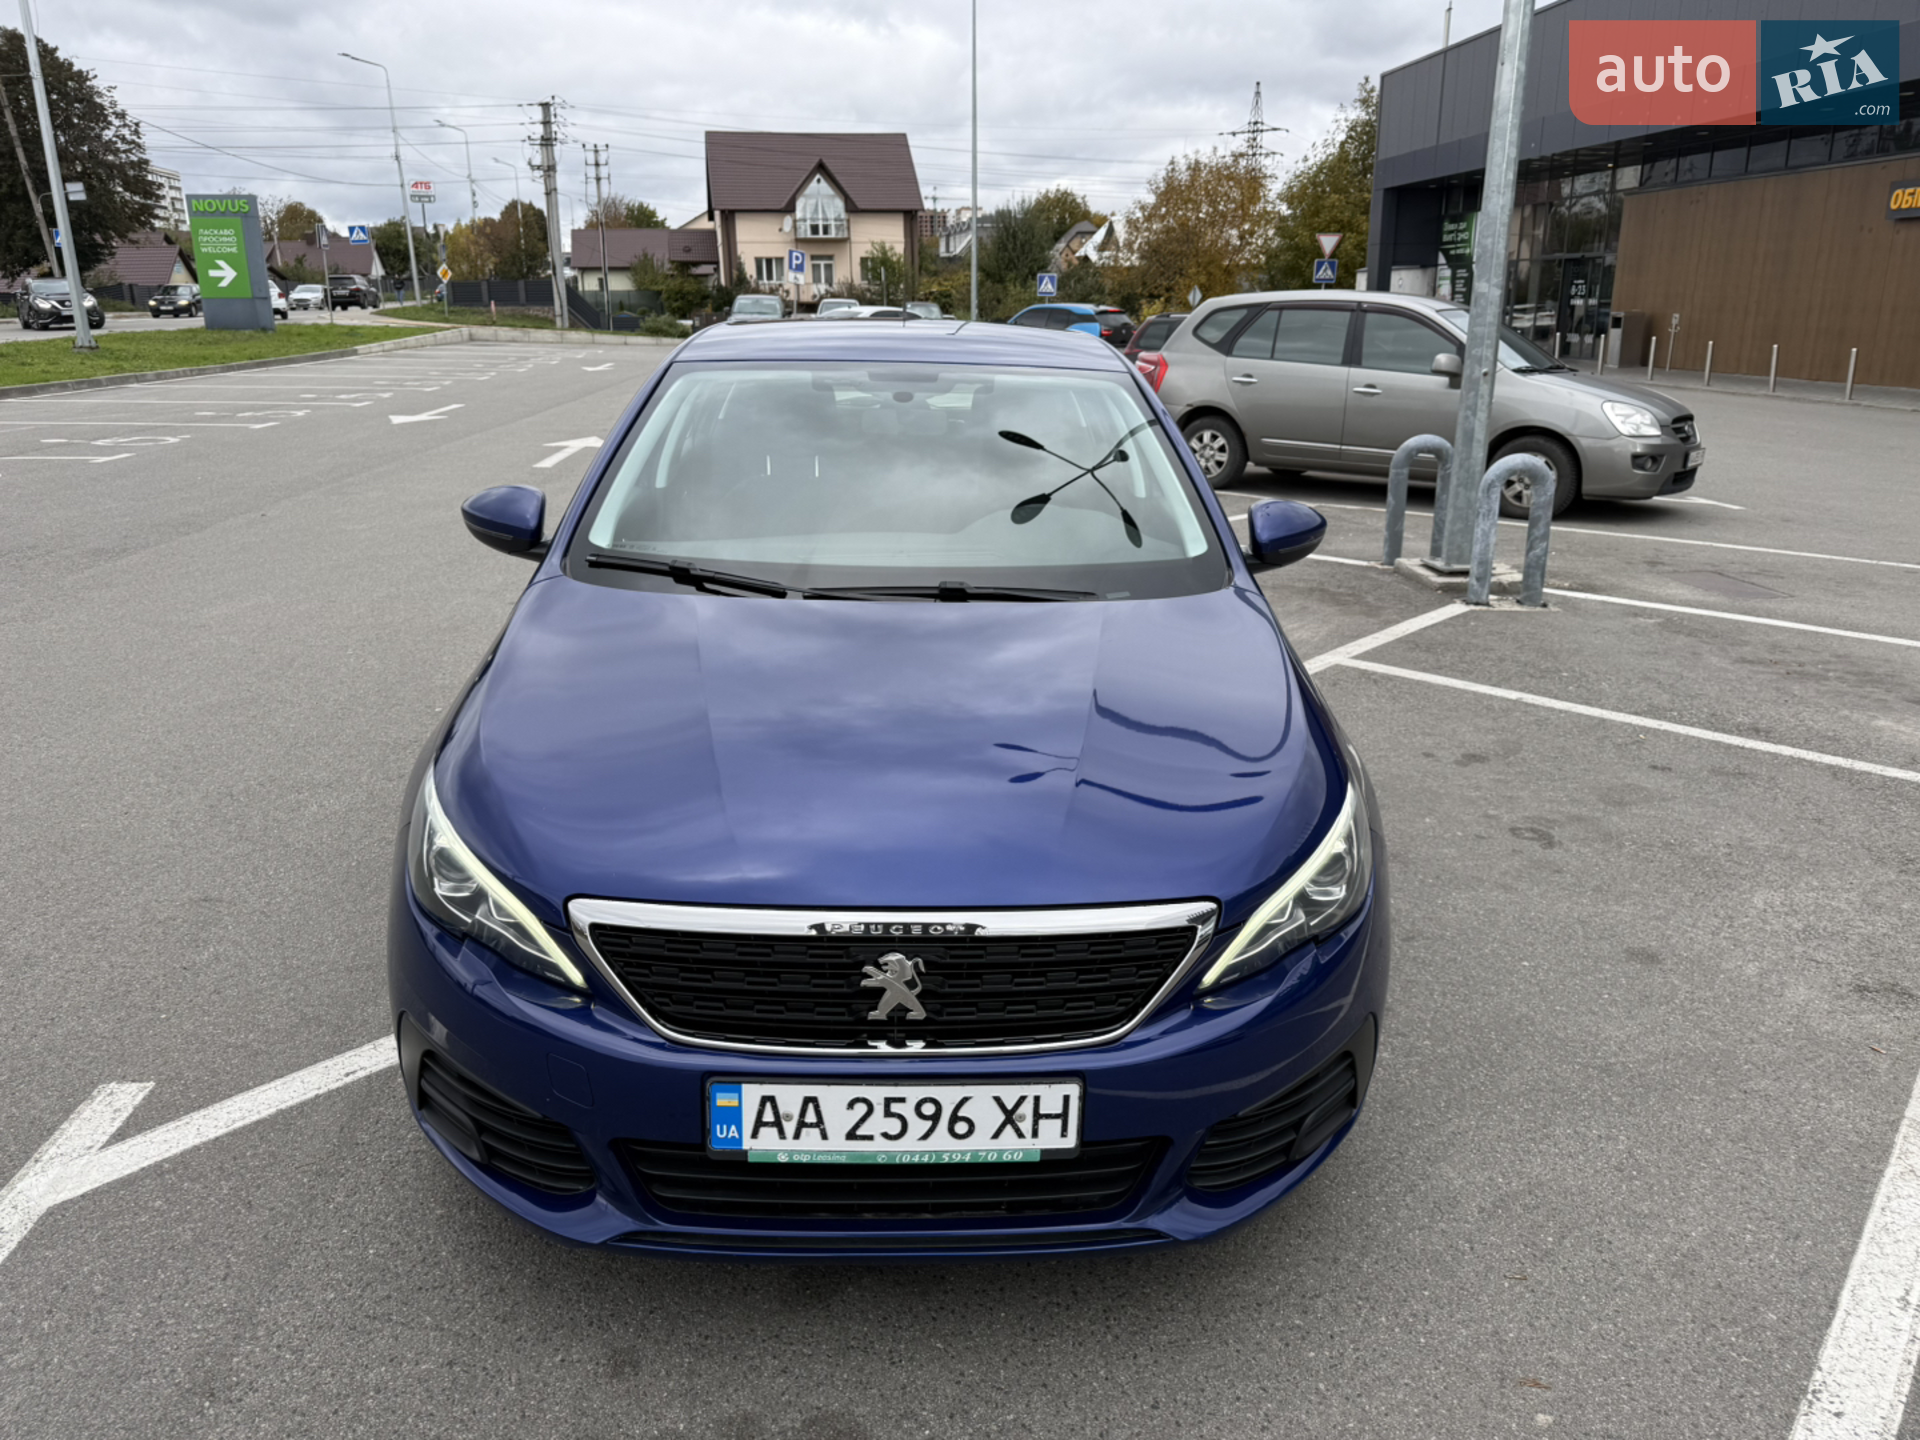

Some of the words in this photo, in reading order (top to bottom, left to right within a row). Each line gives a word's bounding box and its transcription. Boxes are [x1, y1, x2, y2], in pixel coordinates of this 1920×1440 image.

[191, 199, 251, 214] NOVUS
[792, 251, 803, 270] P
[830, 923, 966, 935] PEUGEOT
[750, 1095, 829, 1141] AA
[845, 1095, 976, 1141] 2596
[990, 1094, 1071, 1140] XH
[716, 1125, 741, 1140] UA
[793, 1152, 811, 1163] otp
[895, 1151, 936, 1164] (044)
[939, 1151, 971, 1163] 594
[978, 1150, 998, 1163] 70
[1002, 1150, 1024, 1162] 60
